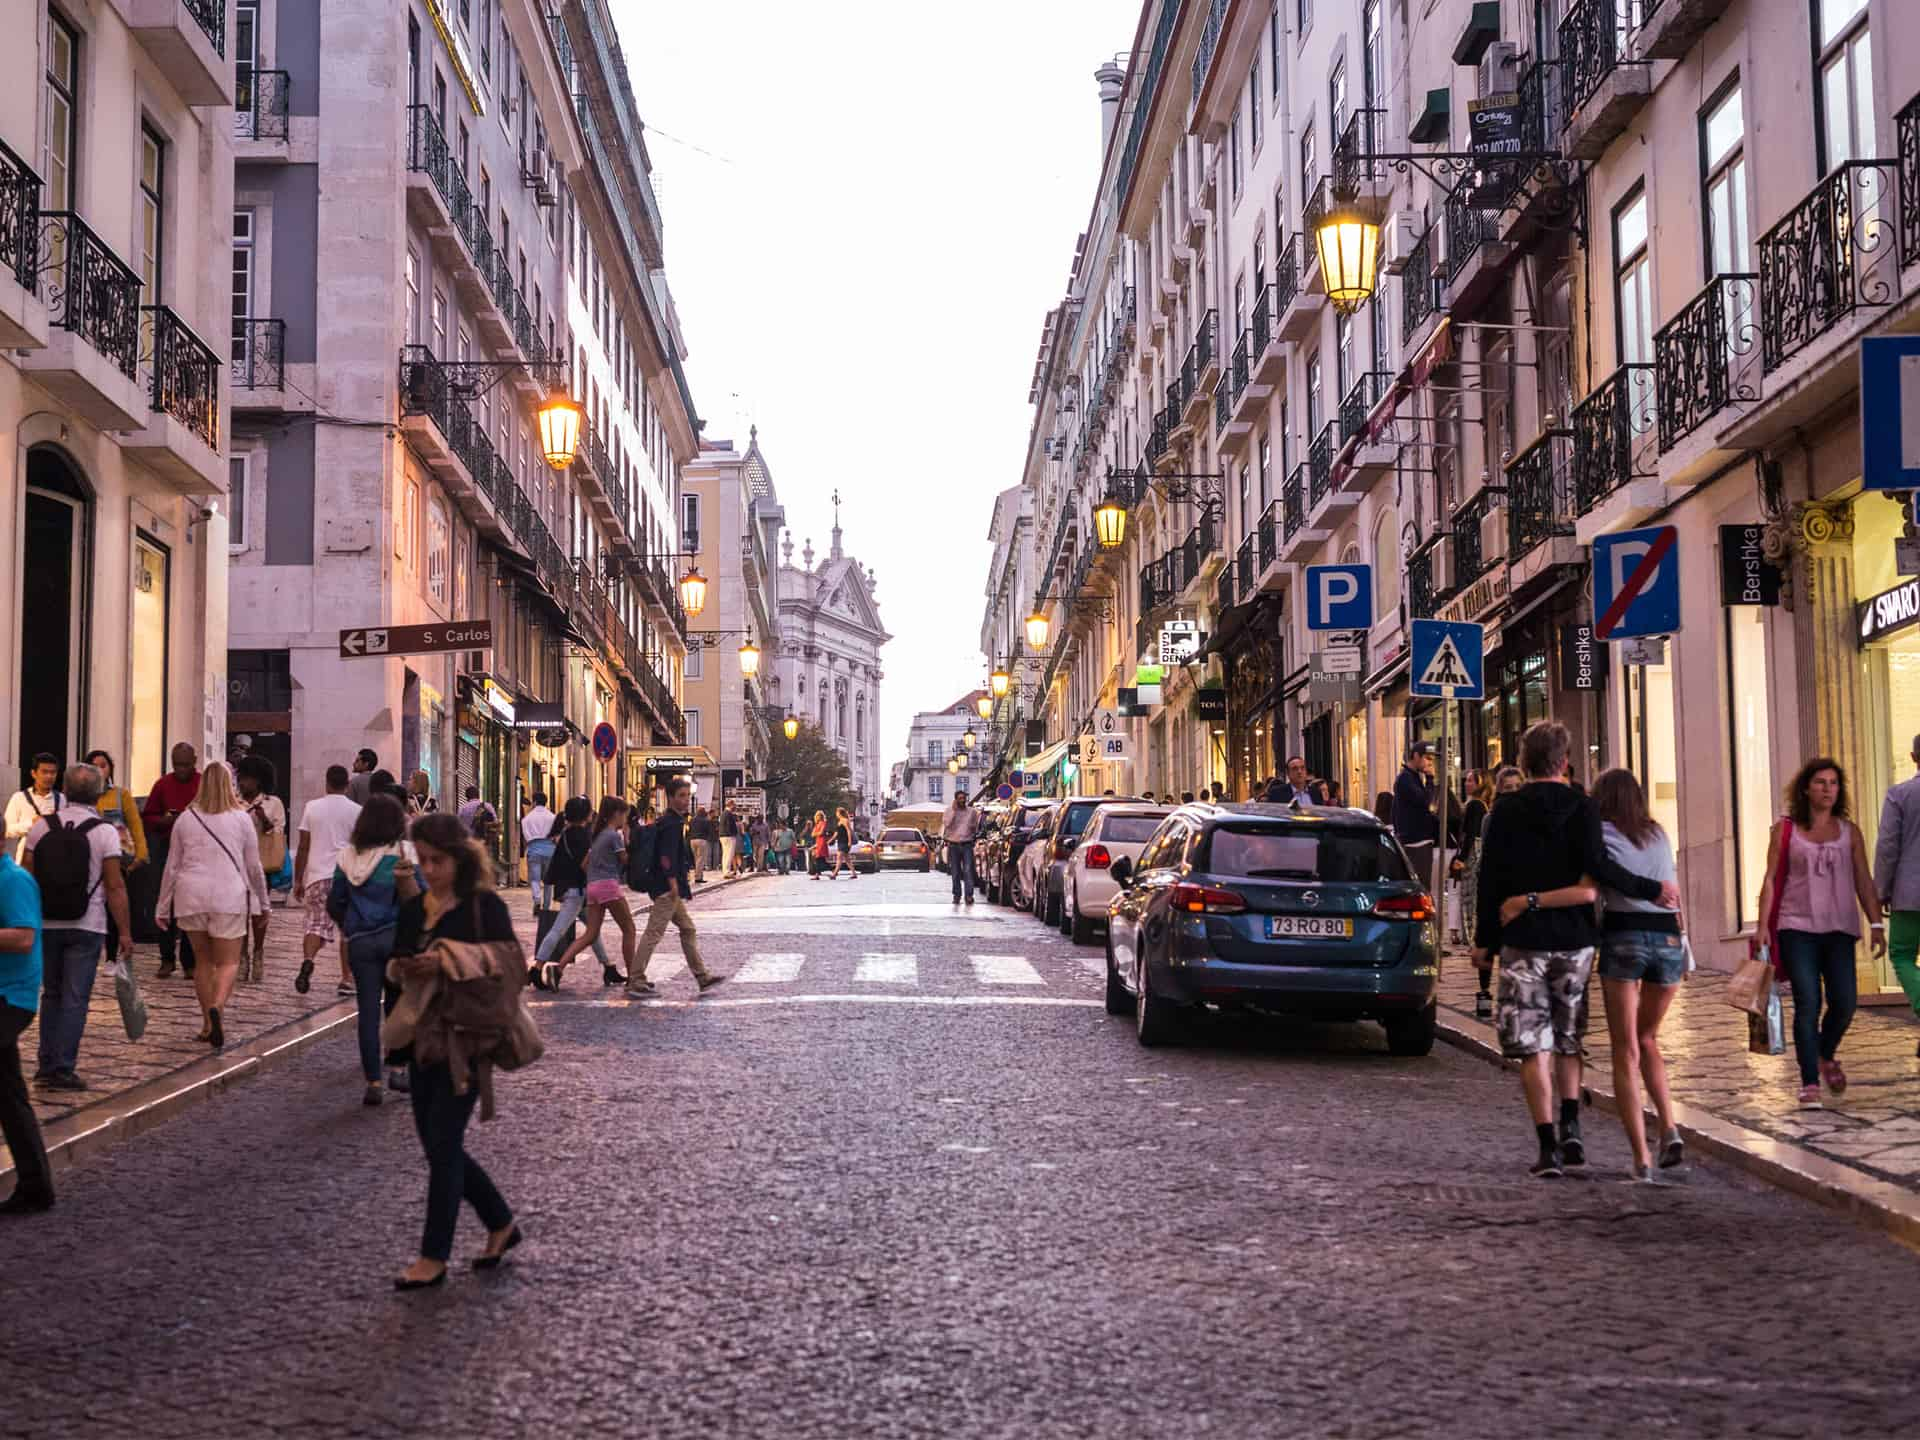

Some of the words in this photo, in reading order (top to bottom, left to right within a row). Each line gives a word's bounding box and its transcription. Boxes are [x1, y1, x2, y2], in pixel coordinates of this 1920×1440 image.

[1475, 112, 1506, 124] Century
[1610, 540, 1660, 629] P
[1741, 528, 1761, 602] Bershka
[1320, 571, 1358, 624] P
[423, 631, 437, 644] S.
[446, 629, 490, 642] Carlos
[1576, 627, 1592, 688] Bershka
[1107, 740, 1123, 753] AB
